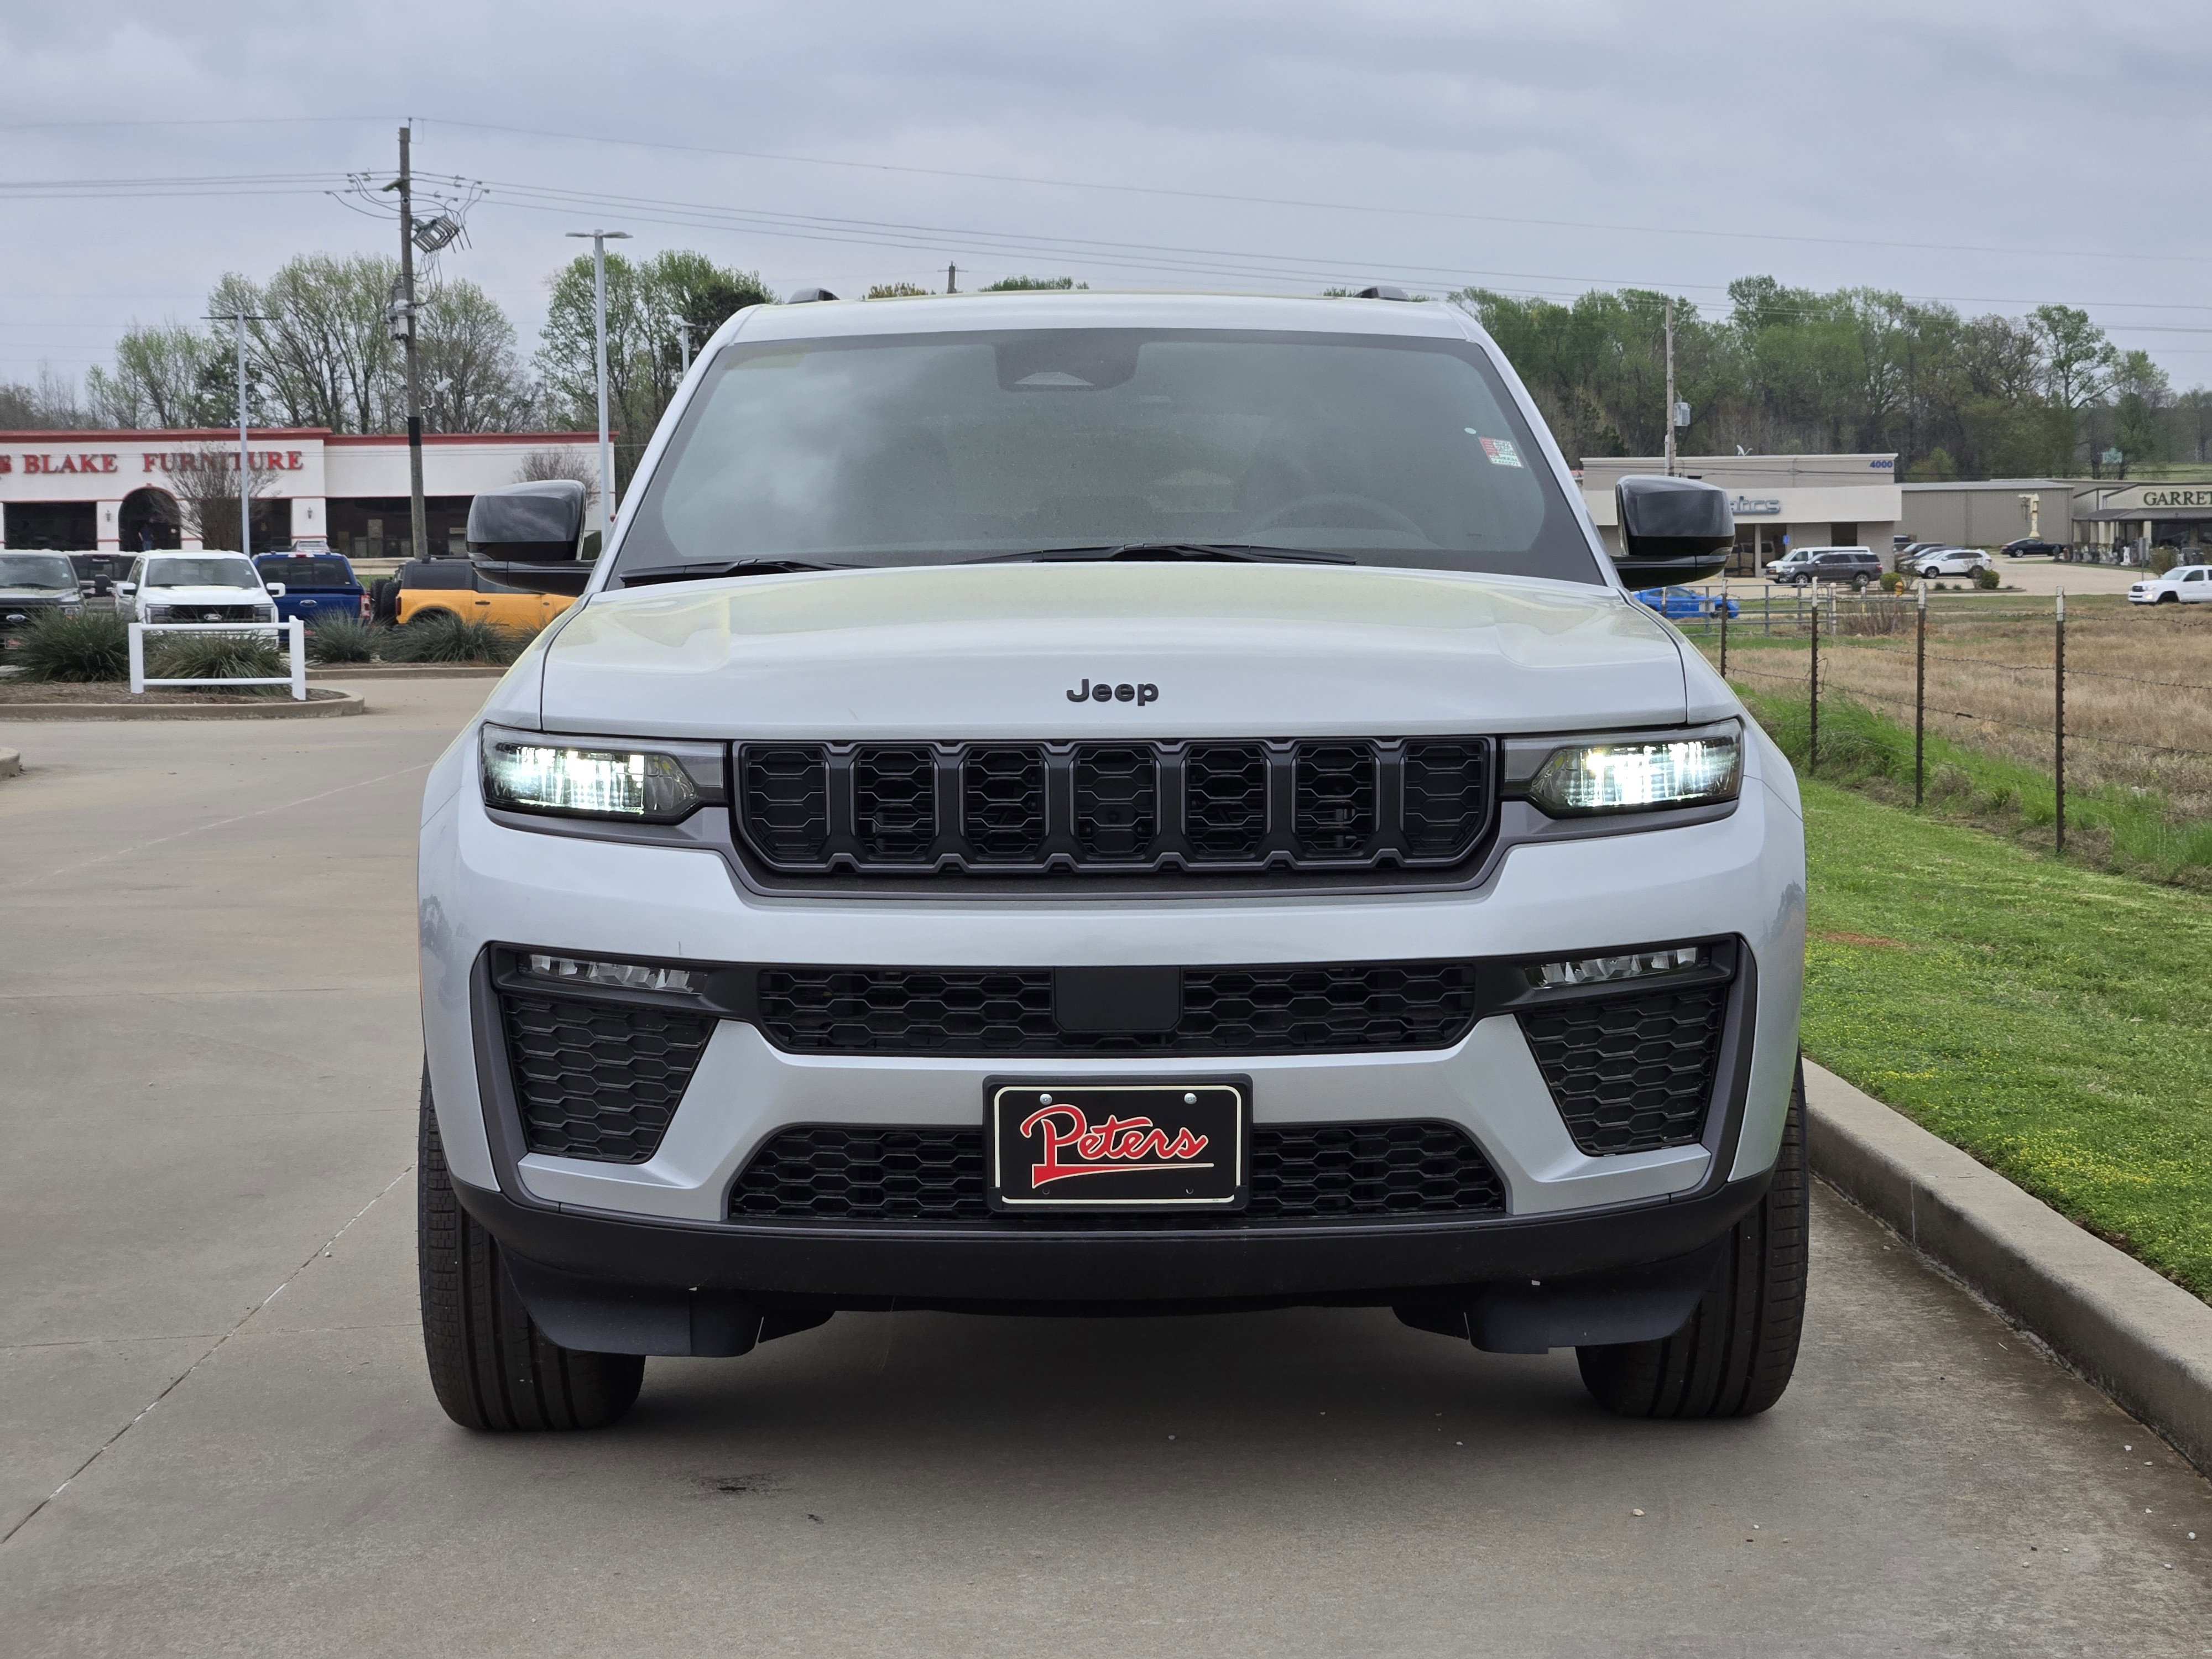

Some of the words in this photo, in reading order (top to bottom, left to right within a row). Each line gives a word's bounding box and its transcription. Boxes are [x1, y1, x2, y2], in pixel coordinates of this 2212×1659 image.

[23, 453, 118, 473] BLAKE
[142, 451, 304, 472] FURNITURE
[1066, 678, 1159, 706] Jeep
[1020, 1104, 1210, 1168] Peters
